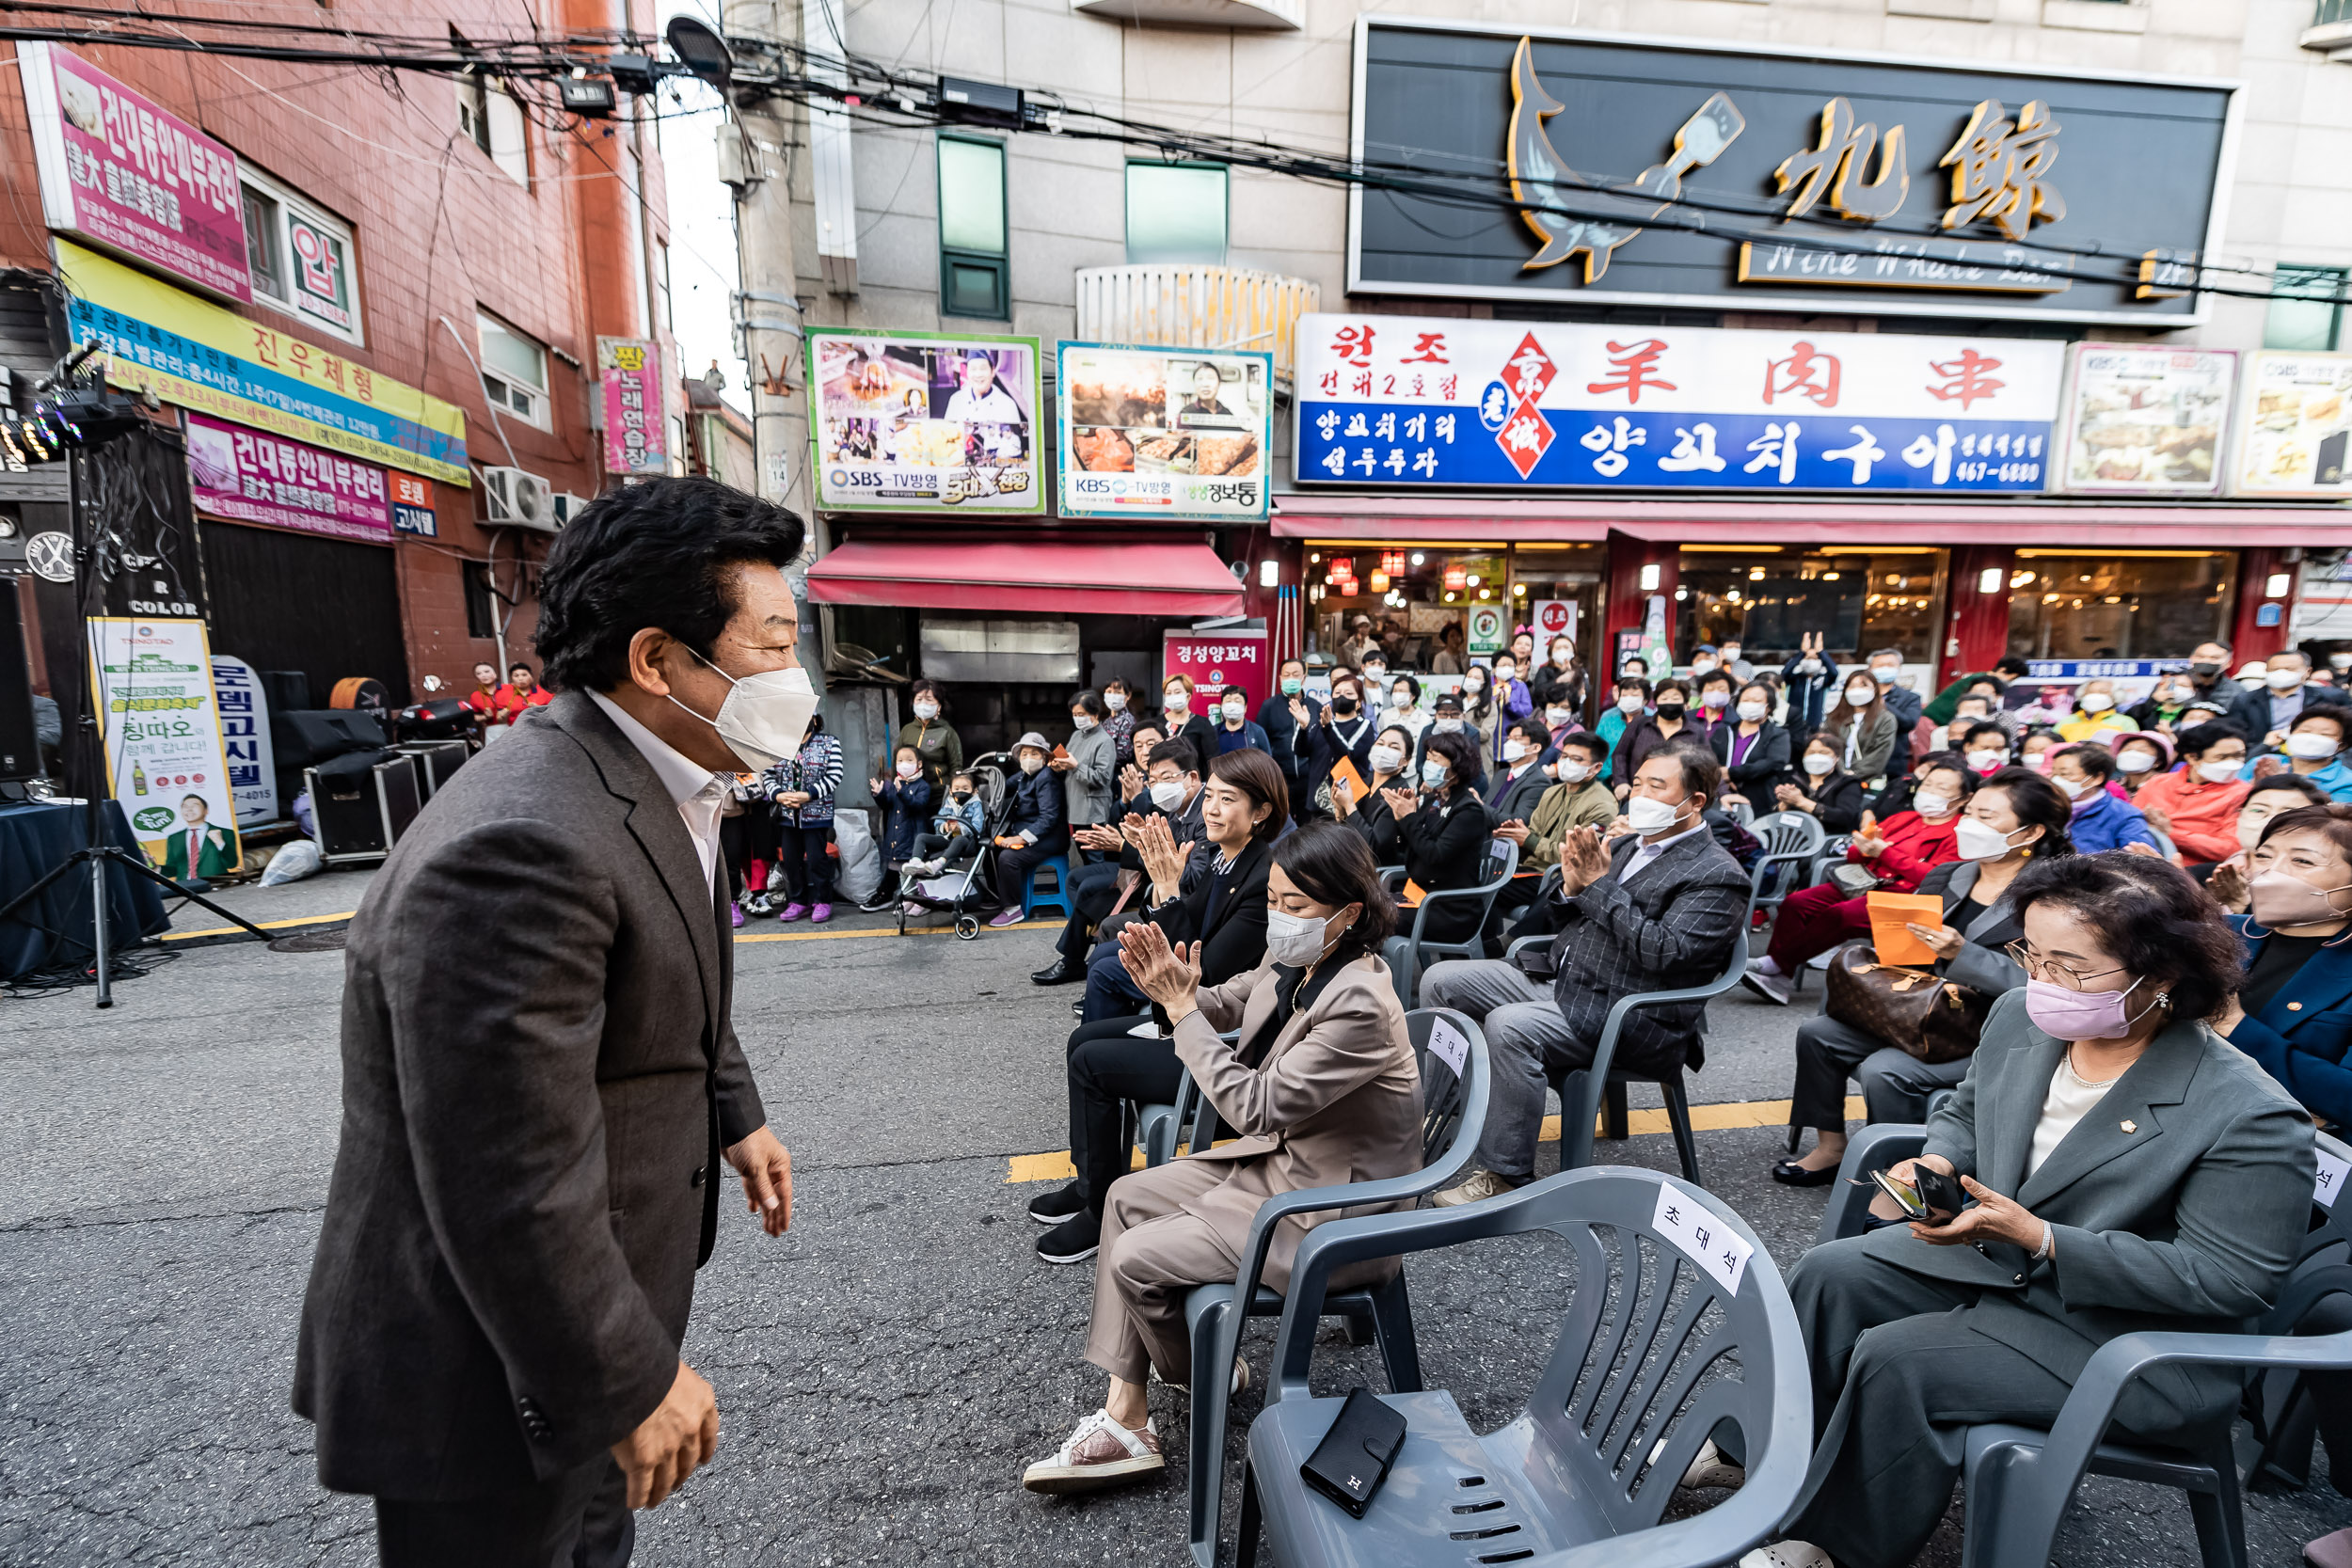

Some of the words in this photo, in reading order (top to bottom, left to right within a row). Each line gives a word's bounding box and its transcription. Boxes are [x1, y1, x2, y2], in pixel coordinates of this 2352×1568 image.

[101, 84, 240, 222] 건대동안피부관리
[614, 346, 646, 371] 짱
[1330, 325, 1450, 368] 원조
[1586, 338, 2008, 413] 羊肉串
[618, 371, 649, 467] 노래연습장
[1316, 409, 1457, 445] 양꼬치거리
[234, 431, 386, 502] 건대동안피부관리
[1322, 446, 1439, 479] 선두주자
[1580, 415, 1957, 486] 양꼬치구이
[1076, 479, 1110, 493] KBS
[395, 507, 436, 536] 고시텔
[130, 600, 199, 616] COLOR
[1177, 645, 1257, 663] 경성양꼬치
[212, 664, 262, 787] 로뎀고시텔
[1664, 1205, 1737, 1275] 초대석
